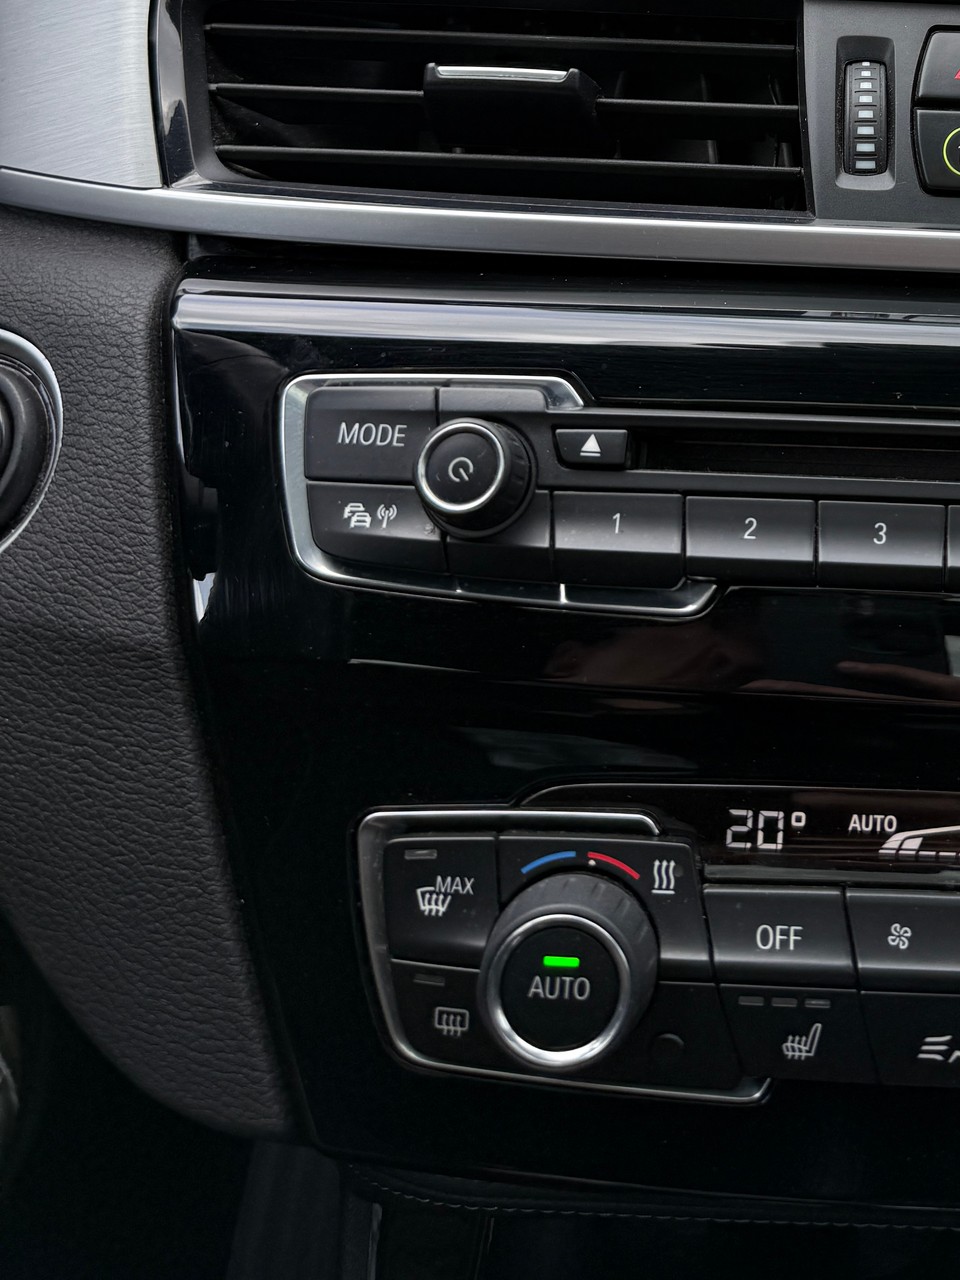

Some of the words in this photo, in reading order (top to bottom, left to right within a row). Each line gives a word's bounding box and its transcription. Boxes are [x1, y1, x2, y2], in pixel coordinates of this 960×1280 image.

[337, 421, 407, 448] MODE
[612, 513, 621, 534] 1
[744, 518, 757, 540] 2
[873, 523, 886, 545] 3
[848, 814, 897, 833] AUTO
[435, 875, 474, 895] MAX
[756, 925, 803, 950] OFF
[528, 976, 591, 1000] AUTO
